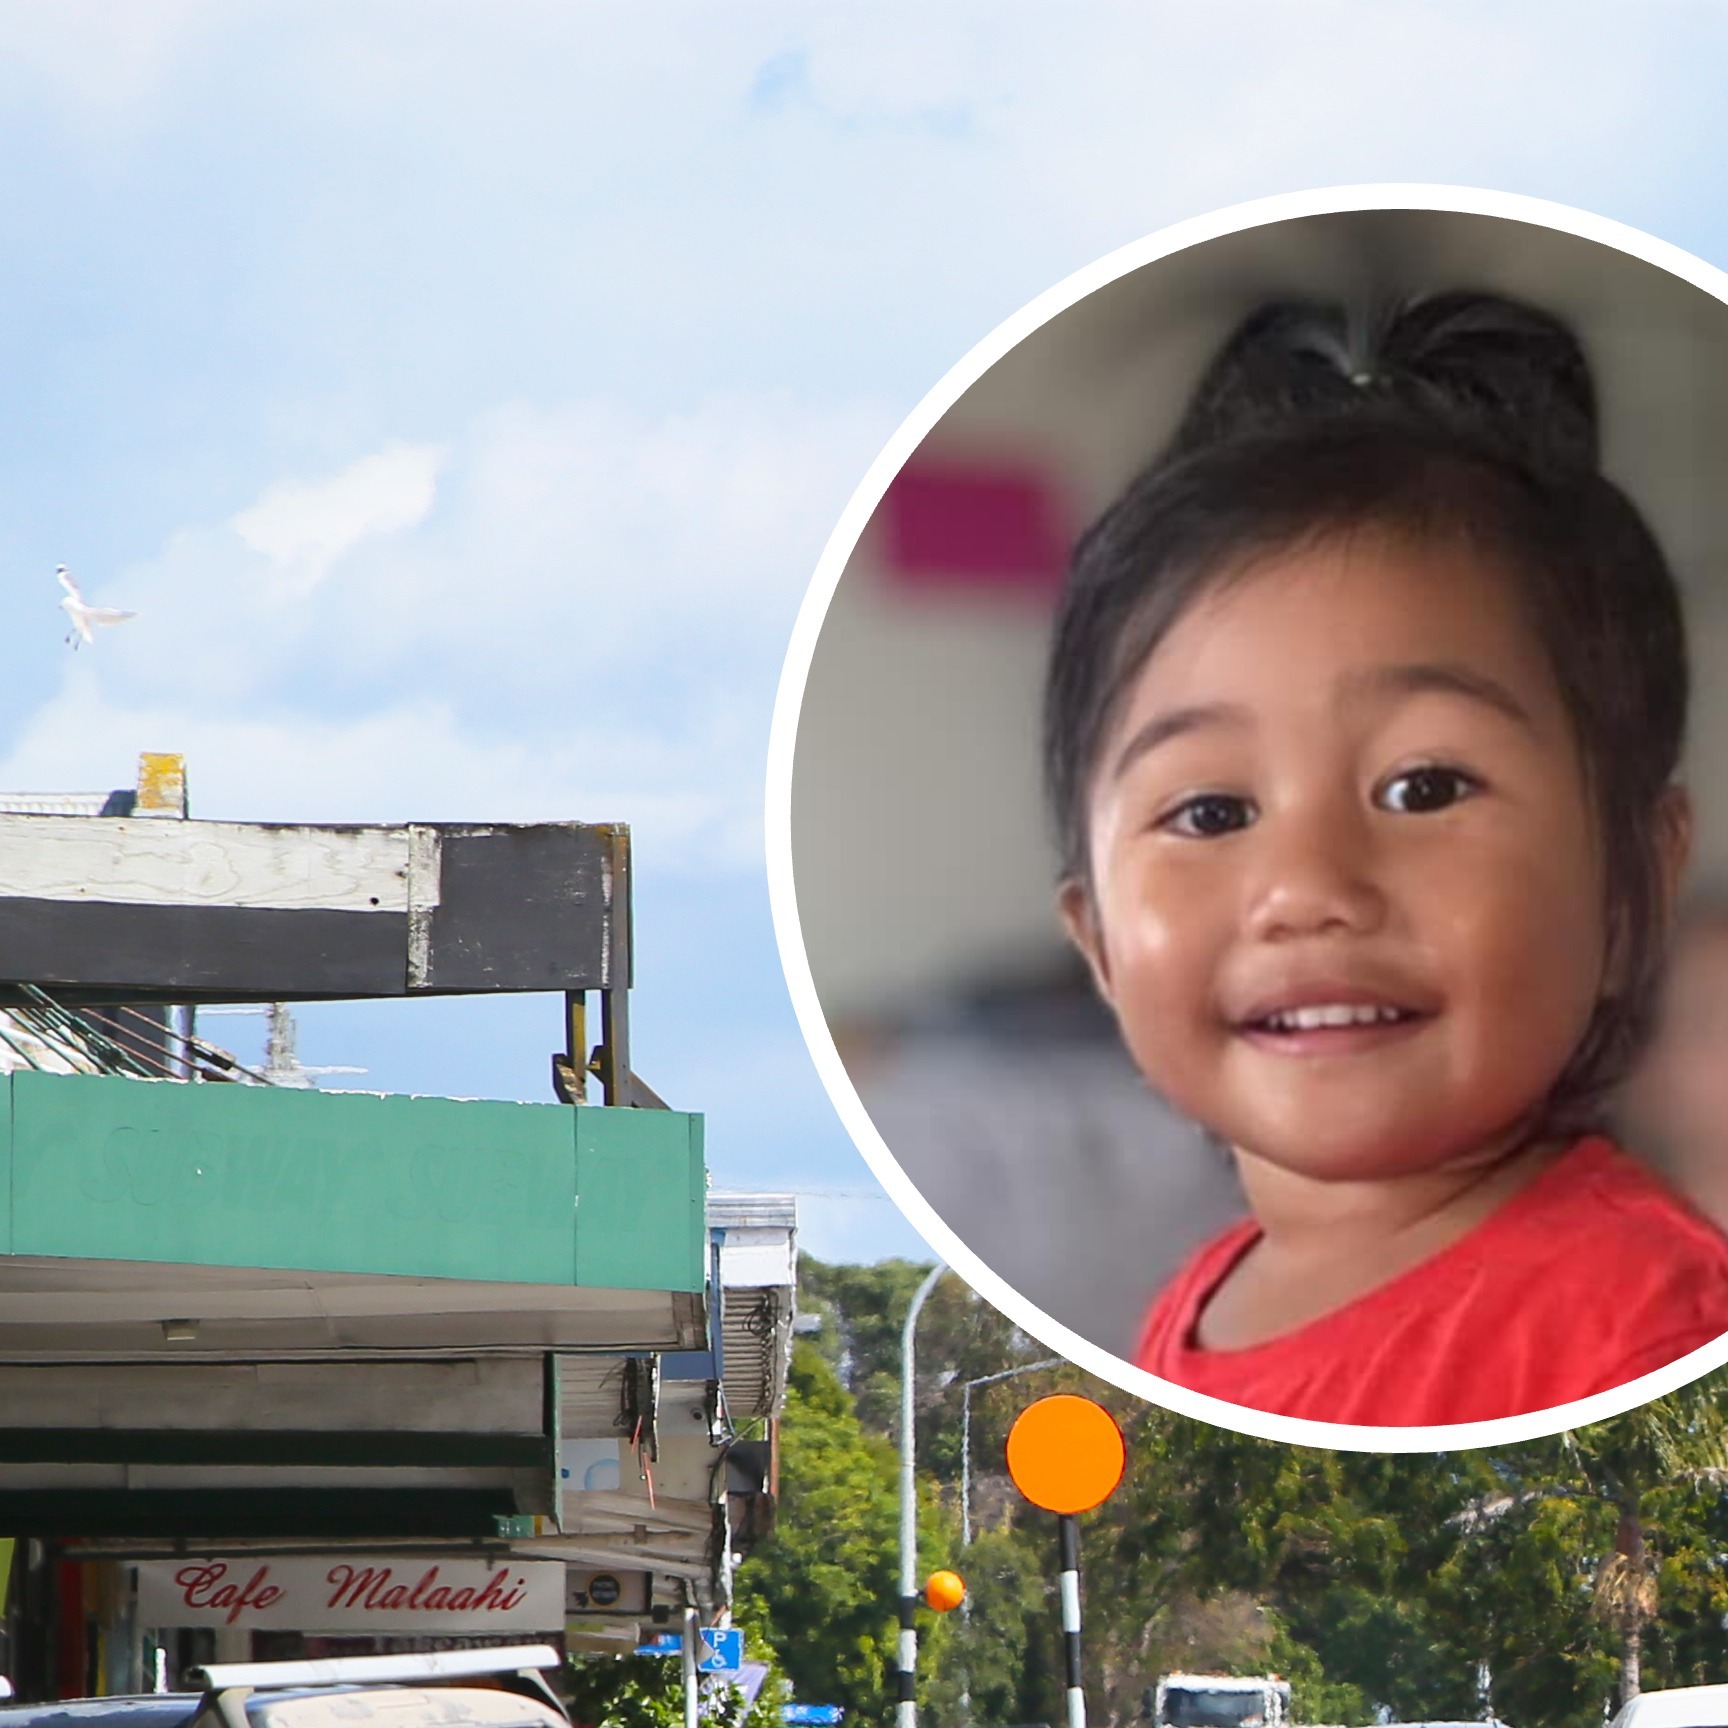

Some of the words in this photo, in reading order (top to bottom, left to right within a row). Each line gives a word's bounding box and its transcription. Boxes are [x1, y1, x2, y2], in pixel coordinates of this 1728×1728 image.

[175, 1563, 287, 1625] Cafe
[326, 1564, 527, 1612] Malaahi
[713, 1632, 727, 1648] P
